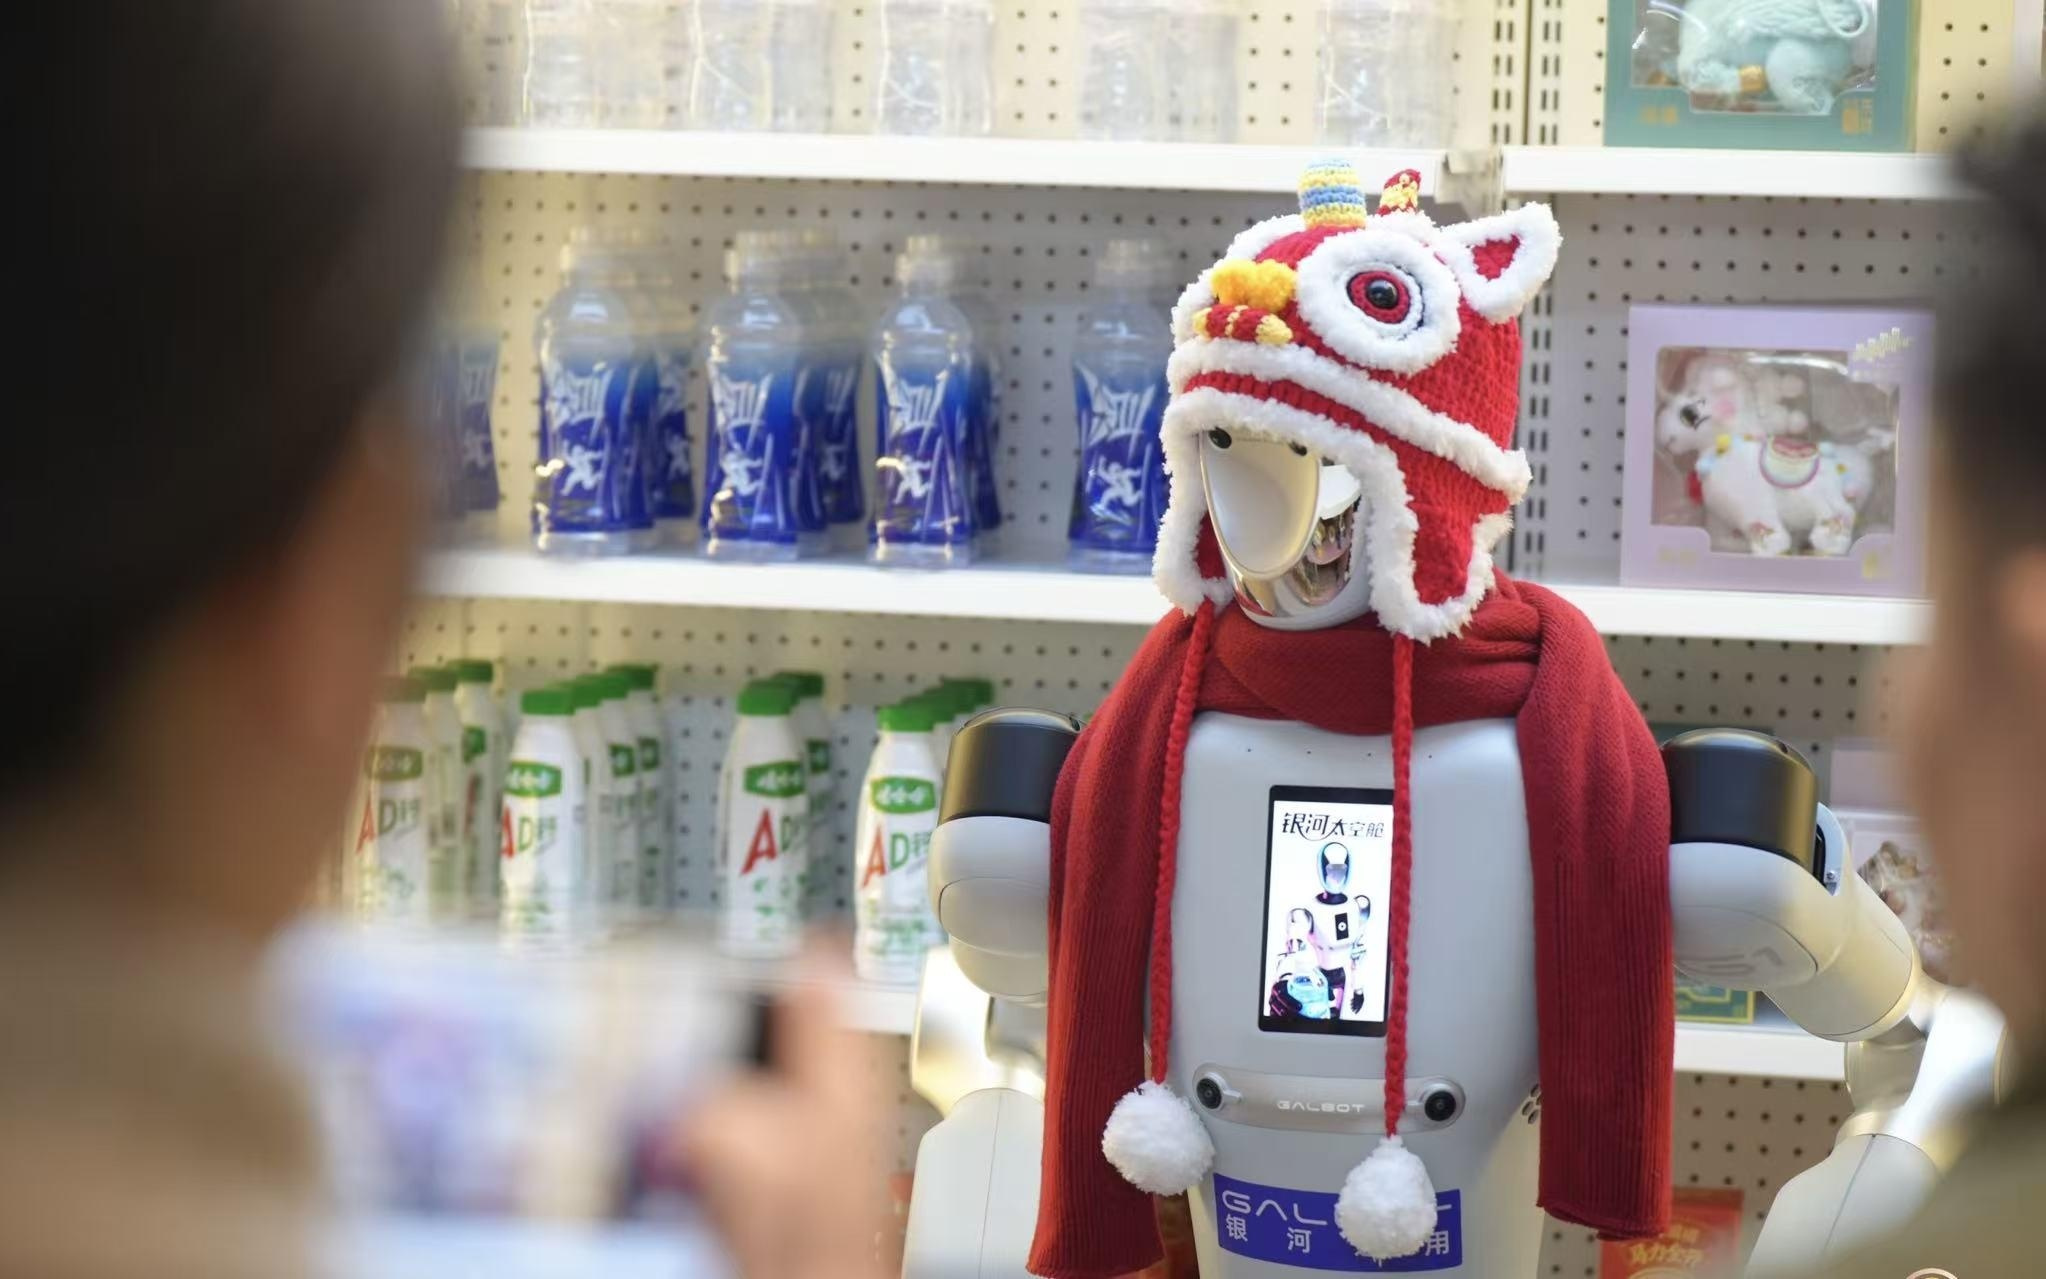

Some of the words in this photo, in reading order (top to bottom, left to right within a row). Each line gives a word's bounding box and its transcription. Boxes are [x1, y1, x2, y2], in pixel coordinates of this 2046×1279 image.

[1282, 812, 1385, 841] 银河太空舱
[1276, 1100, 1365, 1113] GALBOT
[1225, 1213, 1450, 1256] 银河用
